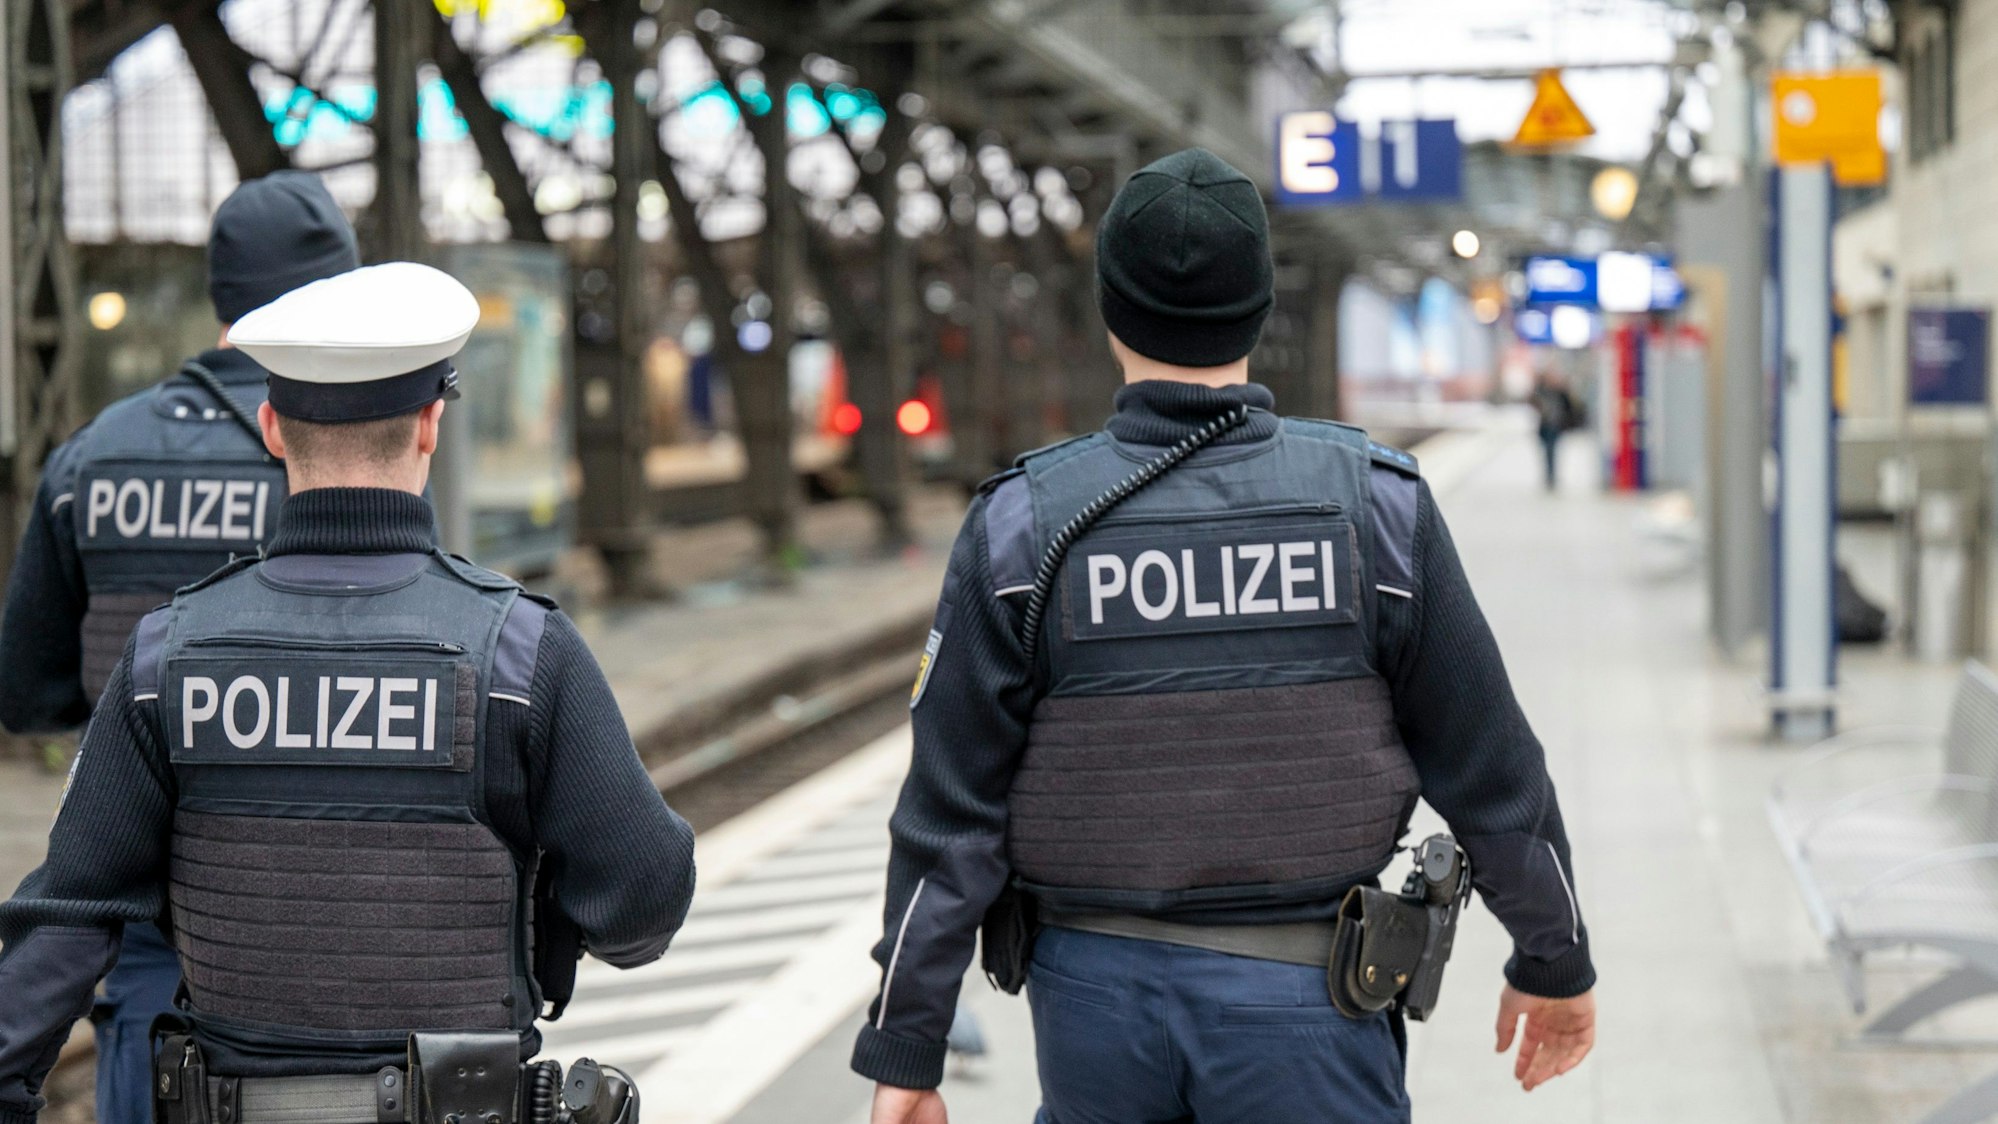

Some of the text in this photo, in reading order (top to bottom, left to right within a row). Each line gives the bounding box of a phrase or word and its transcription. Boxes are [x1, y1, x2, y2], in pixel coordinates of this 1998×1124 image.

[1281, 111, 1339, 193] E
[87, 477, 269, 540] POLIZEI
[1087, 540, 1336, 624] POLIZEI
[182, 674, 438, 751] POLIZEI
